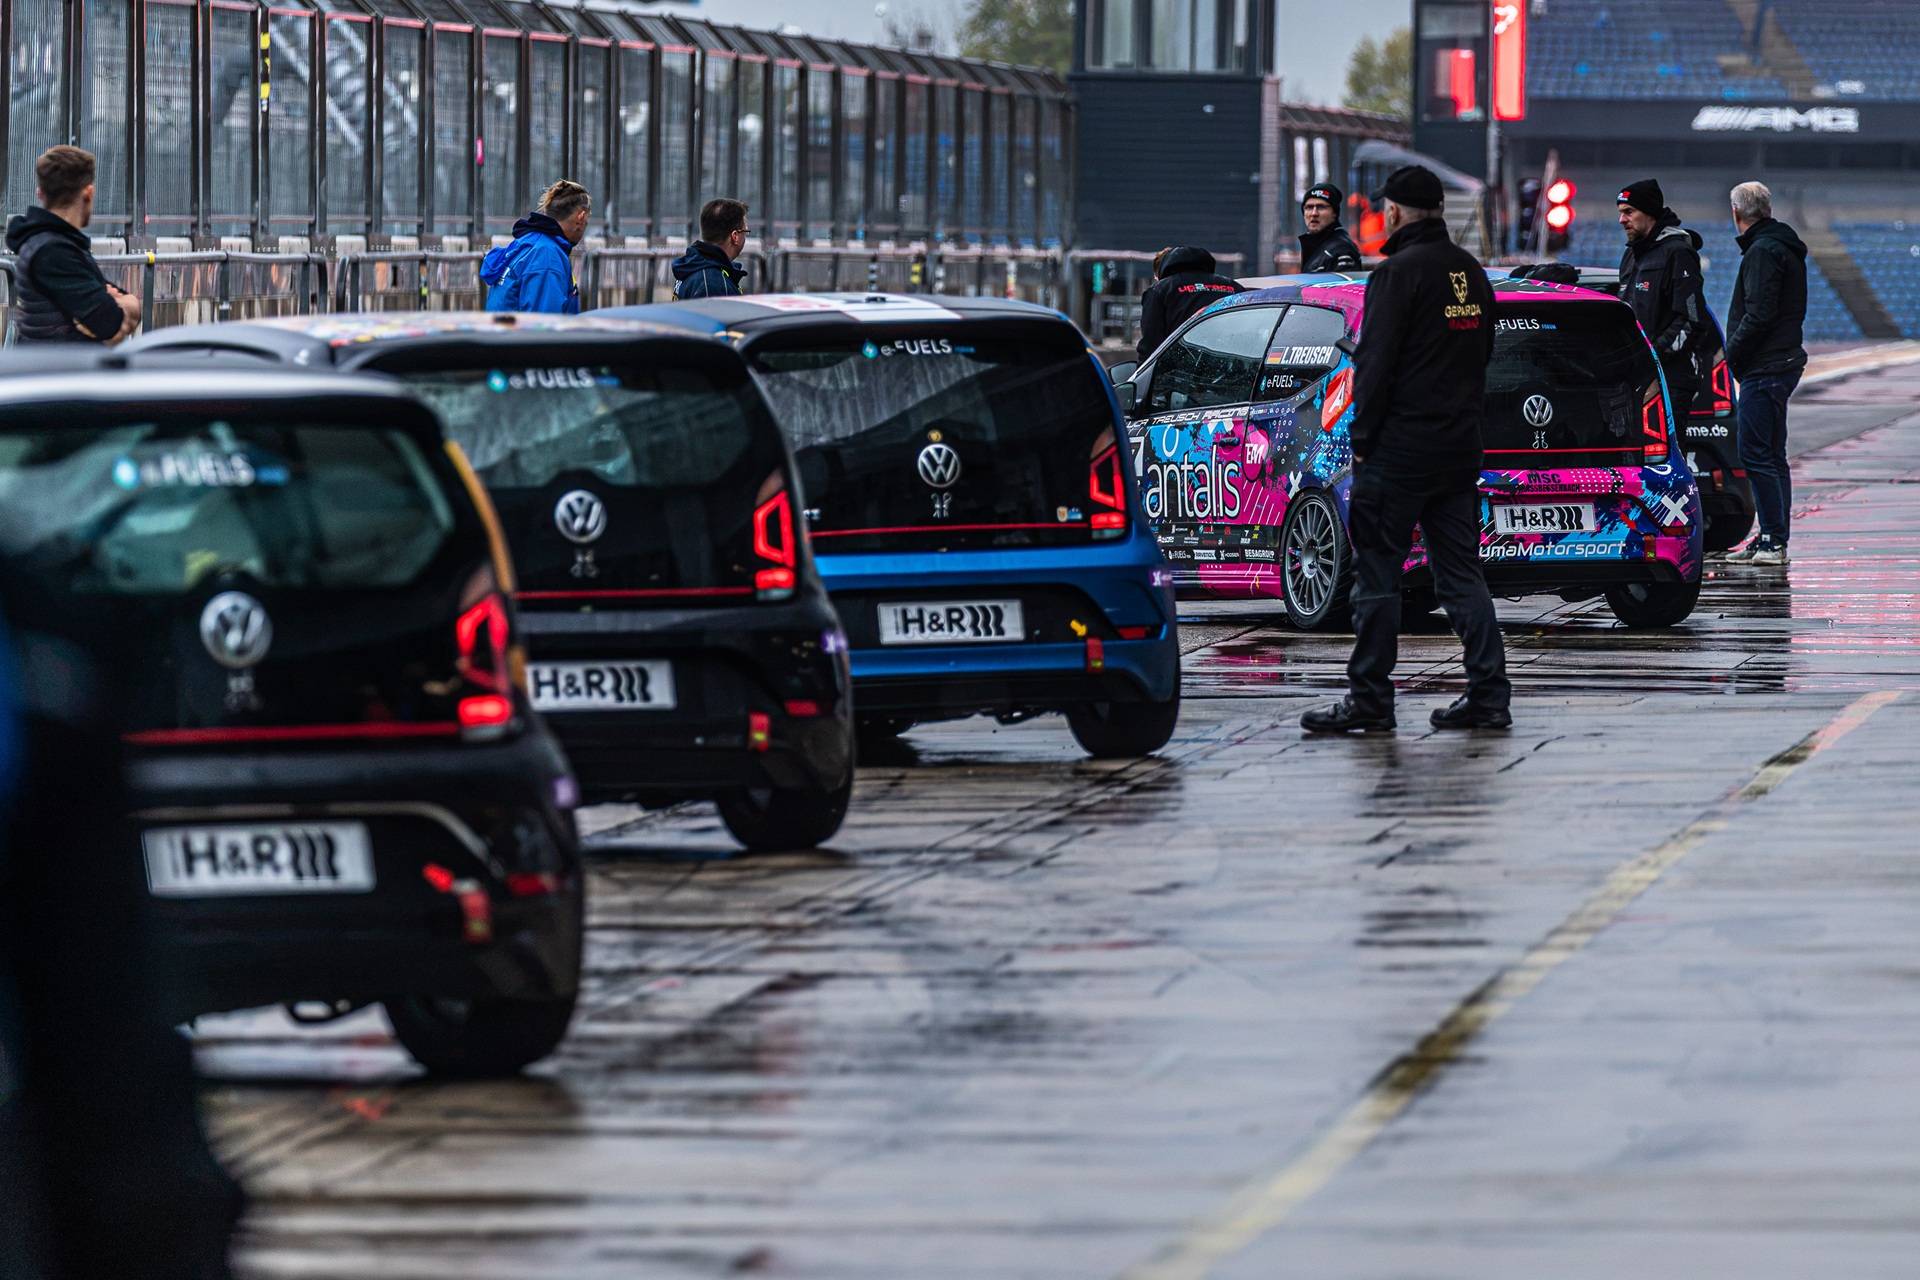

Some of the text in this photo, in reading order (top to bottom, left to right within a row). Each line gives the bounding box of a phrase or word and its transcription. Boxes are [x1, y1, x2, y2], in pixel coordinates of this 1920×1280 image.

[1444, 304, 1482, 318] GEPARDA
[1280, 346, 1334, 365] L.TREUSCH
[1266, 375, 1294, 389] e-FUELS
[1152, 411, 1201, 425] TREUSCH
[1202, 406, 1250, 420] RACING
[1685, 423, 1729, 438] me.de
[1145, 442, 1242, 519] antalis
[1527, 472, 1563, 485] MSC
[1509, 506, 1558, 531] H&R
[1479, 540, 1627, 558] umaMotorsport
[900, 606, 968, 635] H&R
[531, 668, 608, 700] H&R
[180, 828, 284, 880] H&R
